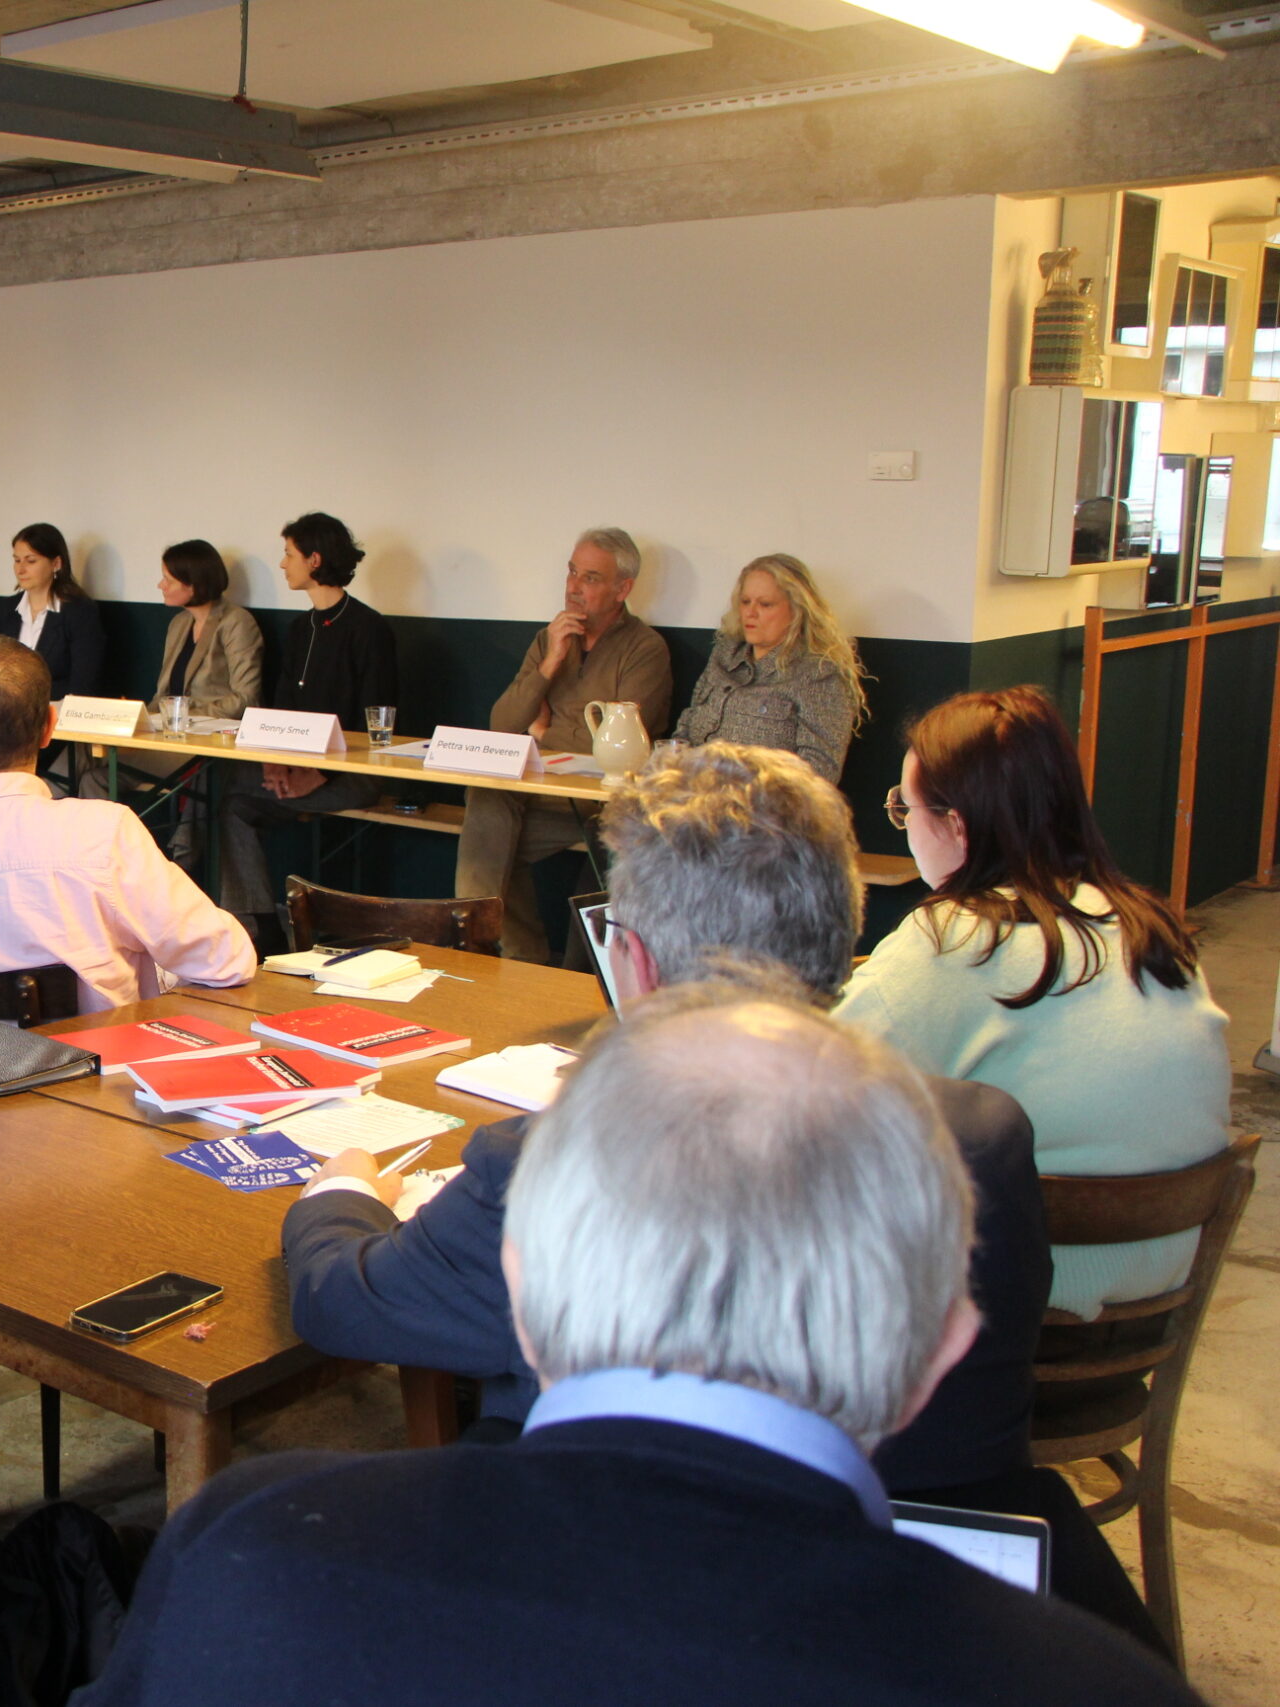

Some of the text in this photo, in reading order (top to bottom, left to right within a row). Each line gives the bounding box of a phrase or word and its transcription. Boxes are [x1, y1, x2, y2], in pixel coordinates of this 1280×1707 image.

[65, 709, 82, 719] Elisa
[259, 723, 310, 736] Ronny Smet
[464, 744, 481, 753] van
[482, 745, 520, 757] Beveren
